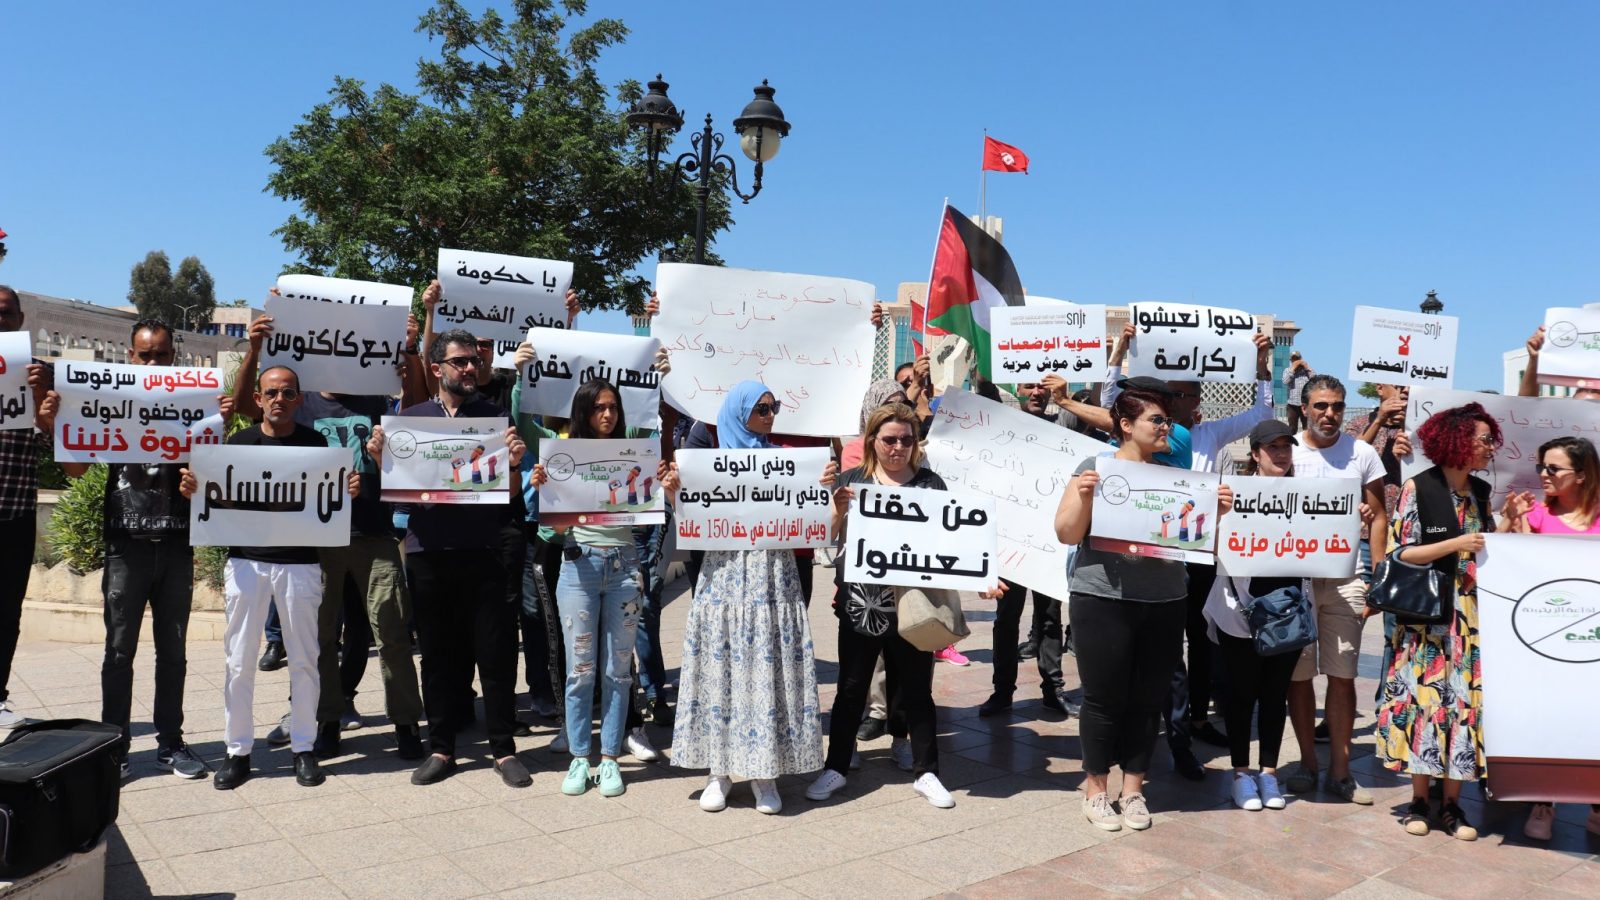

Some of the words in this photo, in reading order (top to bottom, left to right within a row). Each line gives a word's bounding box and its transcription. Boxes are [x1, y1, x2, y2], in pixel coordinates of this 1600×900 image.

[456, 260, 535, 285] حكومة
[542, 270, 557, 293] يا
[437, 299, 515, 324] الشهرية
[756, 286, 837, 312] حكومة
[1066, 309, 1086, 328] snjt
[1133, 305, 1200, 334] نعيشوا
[1207, 309, 1254, 336] نحبوا
[1424, 321, 1442, 340] snjt
[266, 328, 359, 362] كاكتوس
[998, 336, 1060, 353] الوضعيات
[1064, 336, 1101, 352] تسوية
[1398, 335, 1411, 356] لا
[528, 354, 573, 388] حقي
[1002, 357, 1031, 373] مزية
[1036, 356, 1068, 373] موش
[1073, 356, 1093, 372] حق
[1154, 346, 1236, 379] بكرامة
[1357, 356, 1408, 373] الصحفيين
[1410, 365, 1449, 380] لتجويع
[66, 364, 136, 391] سرقوها
[143, 371, 219, 393] كاكتوس
[80, 399, 133, 425] الدولة
[138, 403, 205, 427] موضفو
[62, 423, 129, 458] ذنبنا
[140, 427, 219, 460] شنوة
[713, 454, 757, 477] الدولة
[762, 456, 795, 479] ويني
[198, 464, 307, 522] نستسلم
[316, 466, 347, 524] لن
[679, 484, 746, 508] الحكومة
[751, 484, 791, 507] رئاسة
[796, 485, 830, 509] ويني
[859, 488, 929, 523] حقنا
[942, 499, 988, 532] من
[1233, 492, 1299, 524] الإجتماعية
[1302, 493, 1354, 520] التغطية
[679, 519, 701, 538] عائلة
[707, 518, 729, 539] 150
[750, 521, 764, 546] في
[766, 518, 803, 541] القرارات
[805, 519, 826, 544] ويني
[1228, 531, 1269, 557] مزية
[1274, 531, 1319, 560] موش
[1324, 533, 1351, 553] حق
[854, 538, 989, 581] نعيشوا
